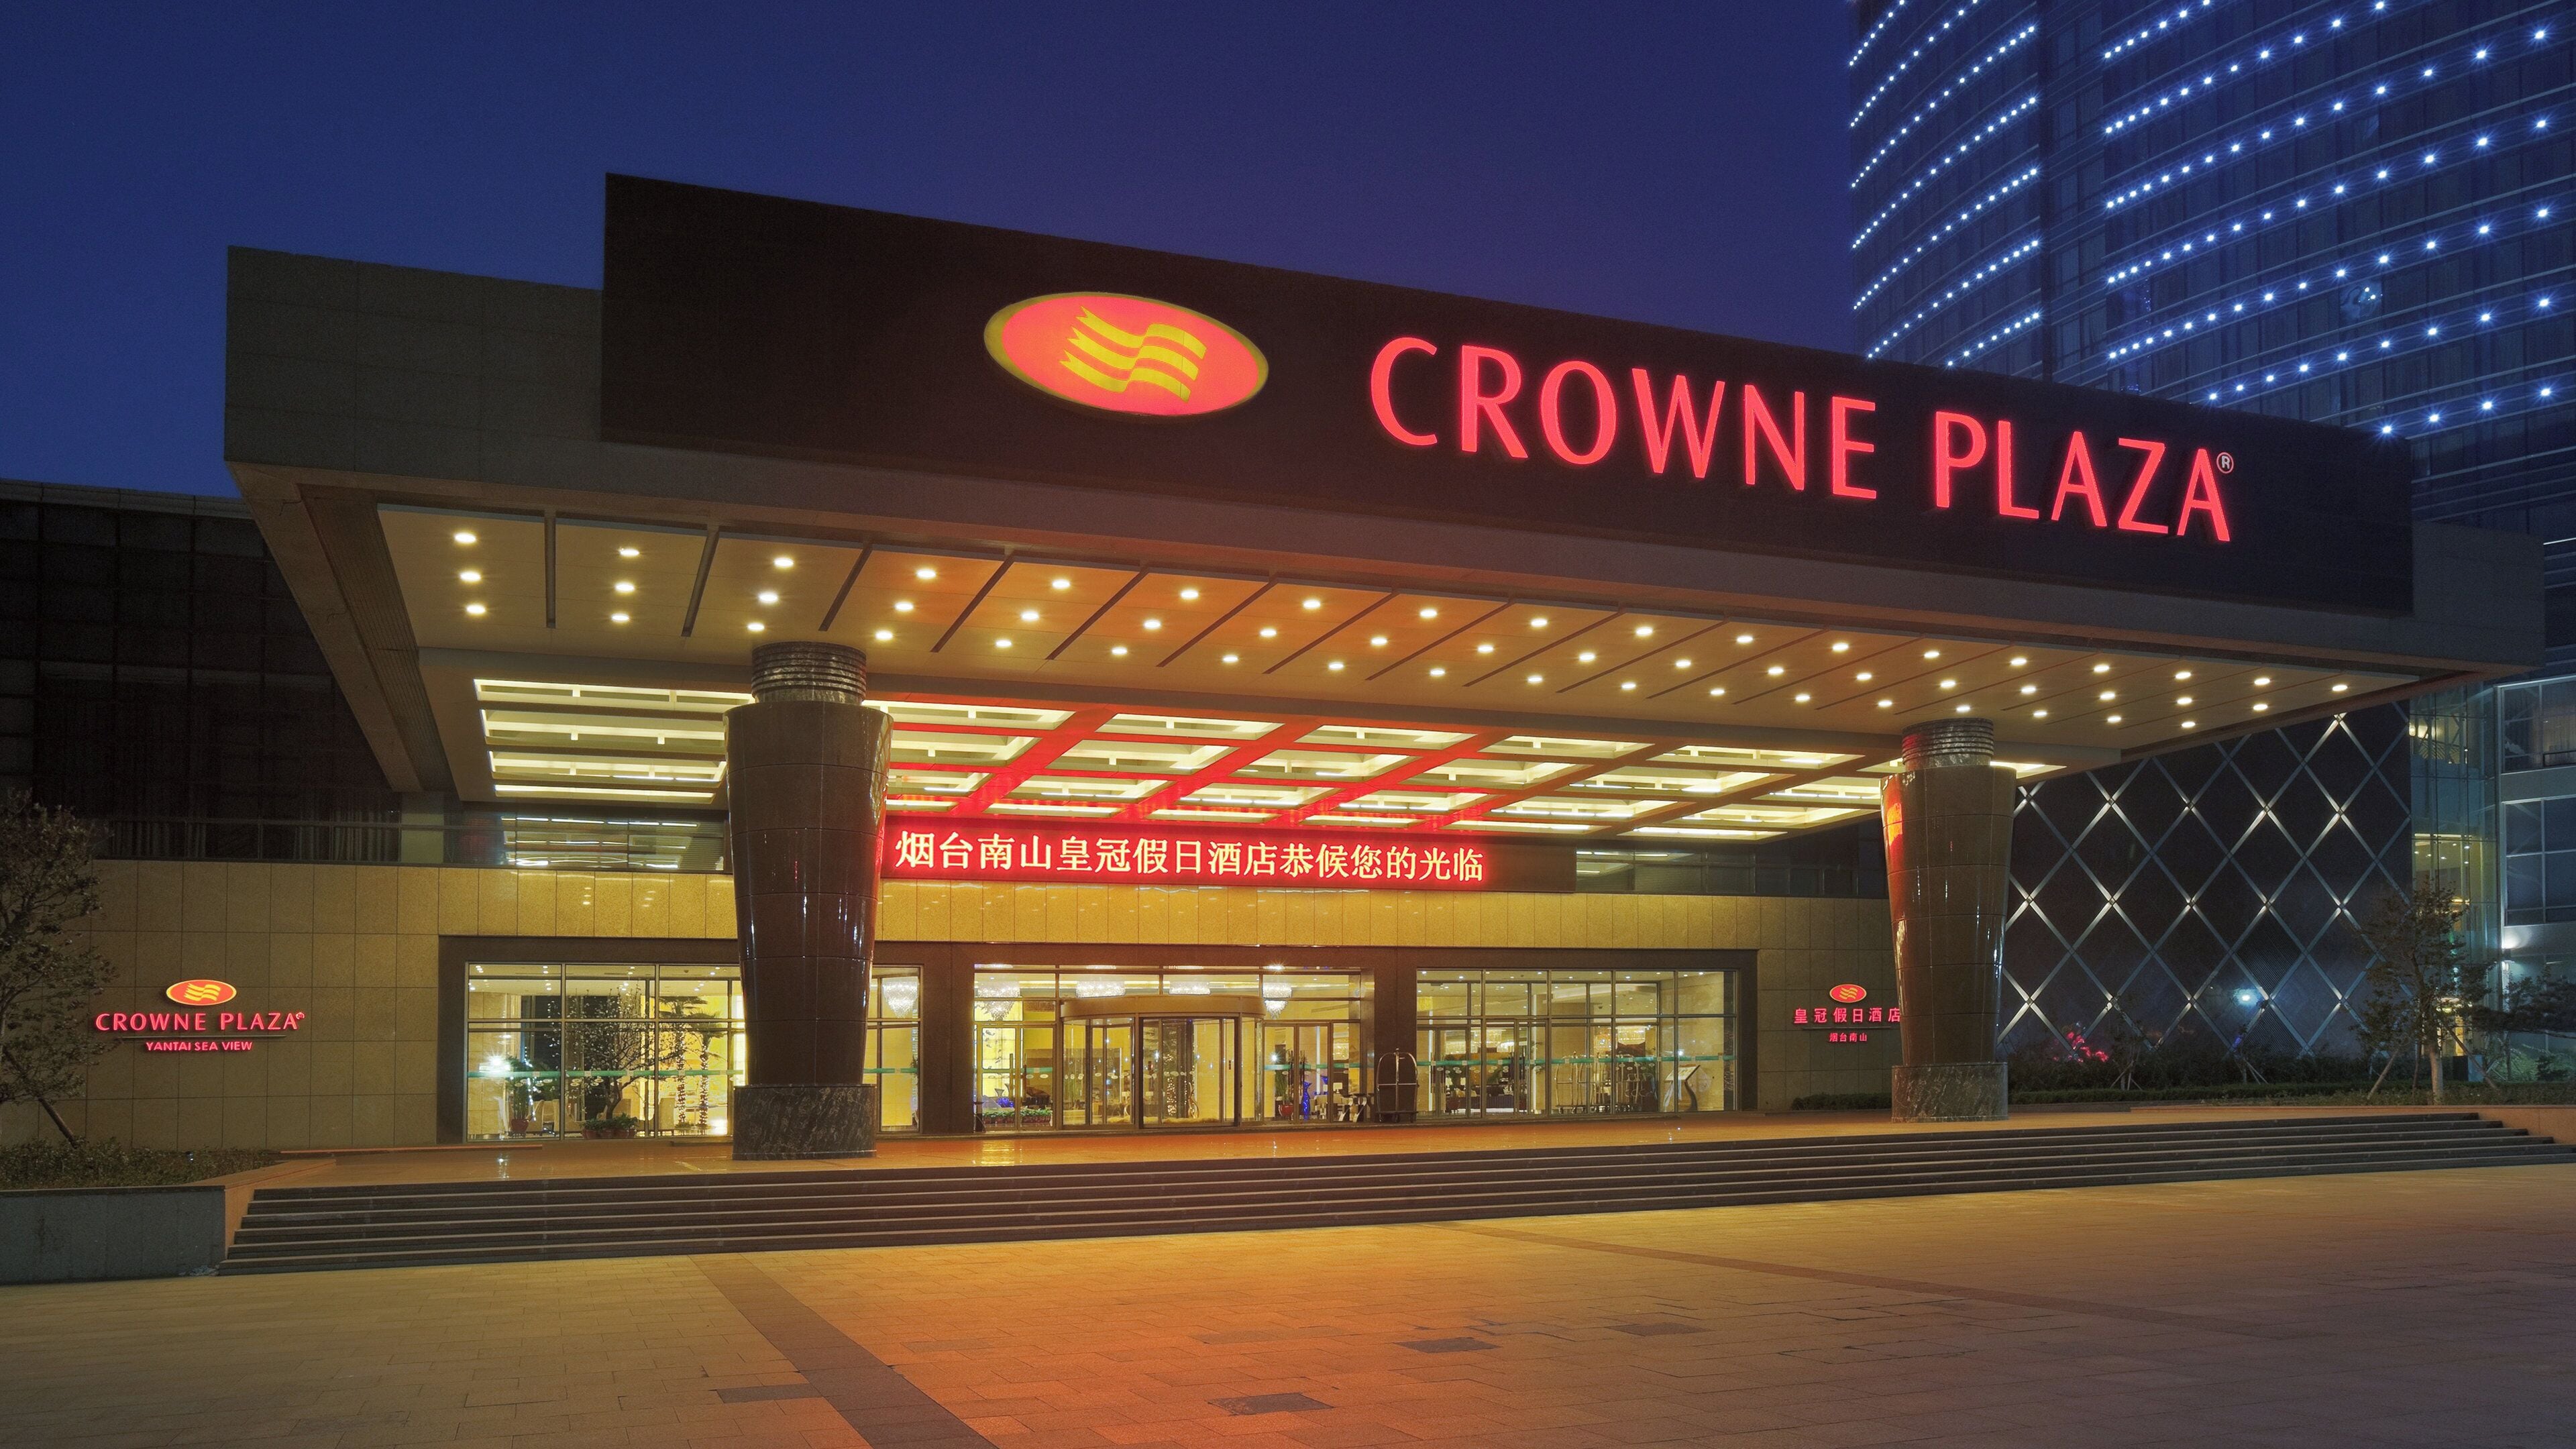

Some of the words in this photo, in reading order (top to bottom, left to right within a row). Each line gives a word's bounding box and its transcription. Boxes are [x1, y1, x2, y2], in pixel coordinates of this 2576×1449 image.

[1370, 336, 1878, 500] CROWNE
[894, 830, 1485, 882] 烟台南山皇冠假日酒店恭候您的光临
[95, 1012, 207, 1031] CROWNE
[1793, 1007, 1901, 1024] 皇冠假日酒店
[146, 1040, 192, 1052] YANTAI
[194, 1040, 219, 1051] SEA
[221, 1040, 253, 1051] VIEW
[1829, 1032, 1868, 1042] 烟台南山
